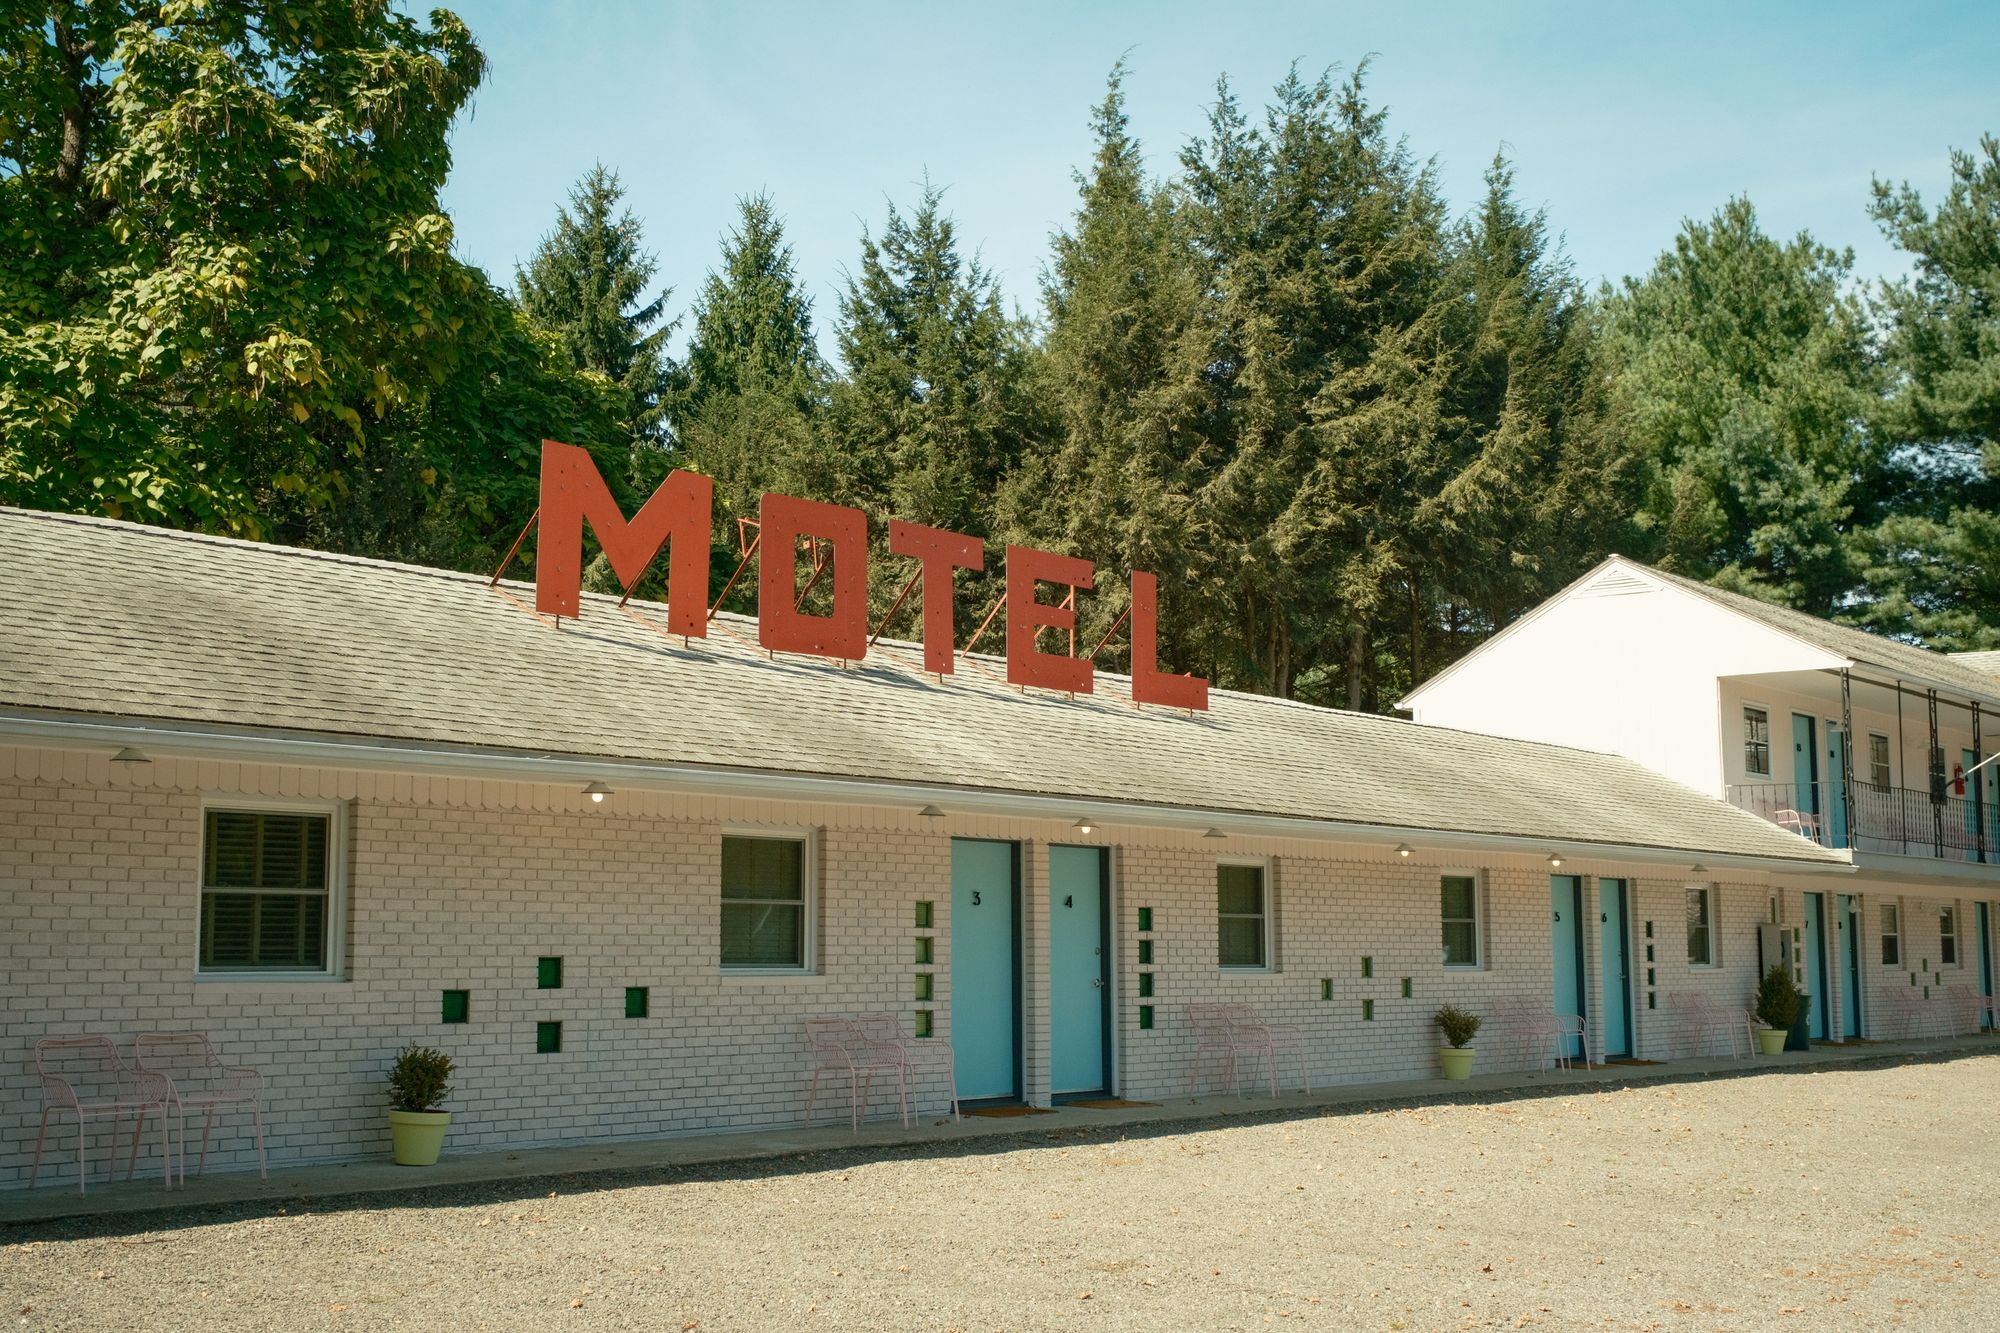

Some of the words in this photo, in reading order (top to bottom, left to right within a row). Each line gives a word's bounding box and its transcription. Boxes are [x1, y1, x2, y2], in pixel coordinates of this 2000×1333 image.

[536, 439, 1208, 711] MOTEL
[972, 891, 981, 906] 3
[1064, 895, 1073, 908] 4
[1554, 912, 1561, 923] 5
[1601, 913, 1608, 923] 6
